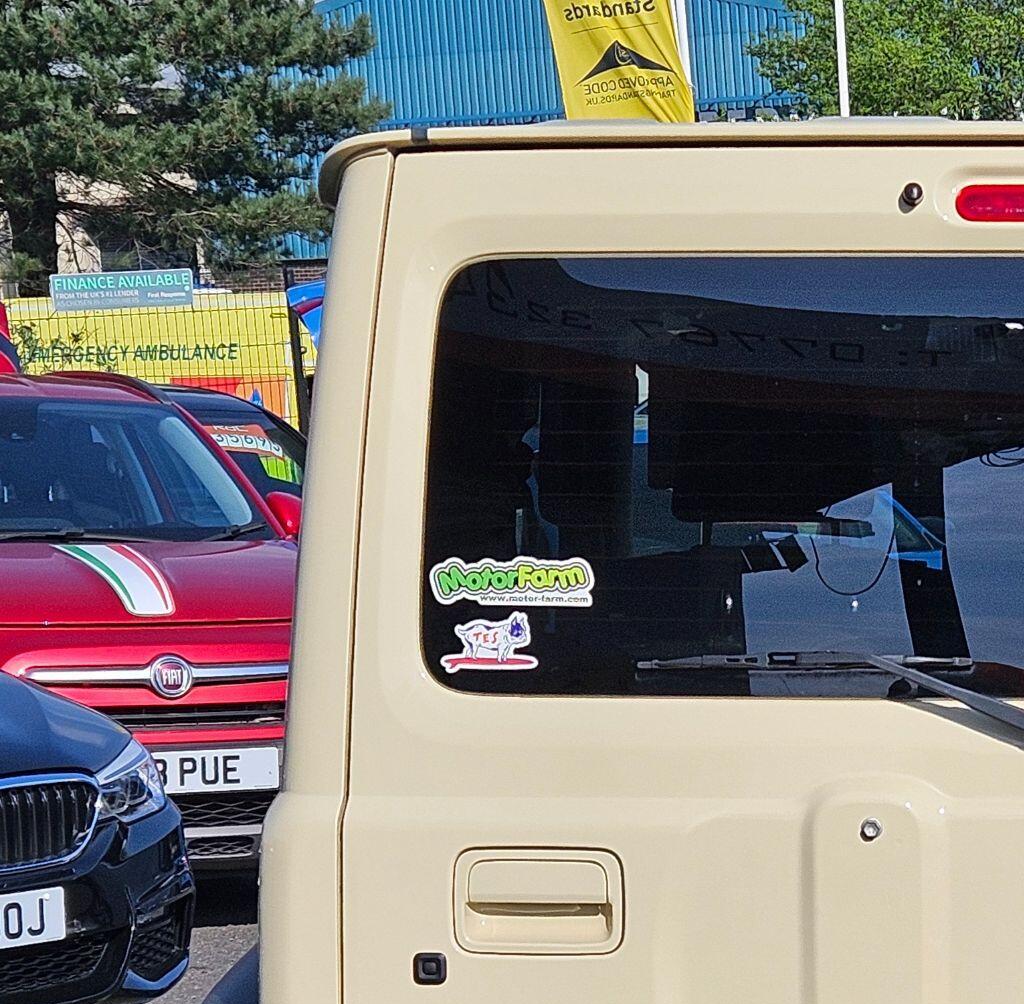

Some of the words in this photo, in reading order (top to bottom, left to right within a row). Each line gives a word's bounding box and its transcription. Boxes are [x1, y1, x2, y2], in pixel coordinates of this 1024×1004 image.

[54, 276, 115, 291] FINANCE
[118, 272, 190, 288] AVAILABLE
[55, 292, 75, 300] FROM
[76, 291, 89, 299] THE
[133, 342, 240, 362] AMBULANCE
[437, 564, 585, 596] MotorFarm
[480, 594, 589, 603] www.motor-farm.com
[473, 632, 499, 644] TES
[161, 669, 182, 685] FIAT
[179, 755, 241, 787] PUE
[4, 898, 46, 940] OJ
